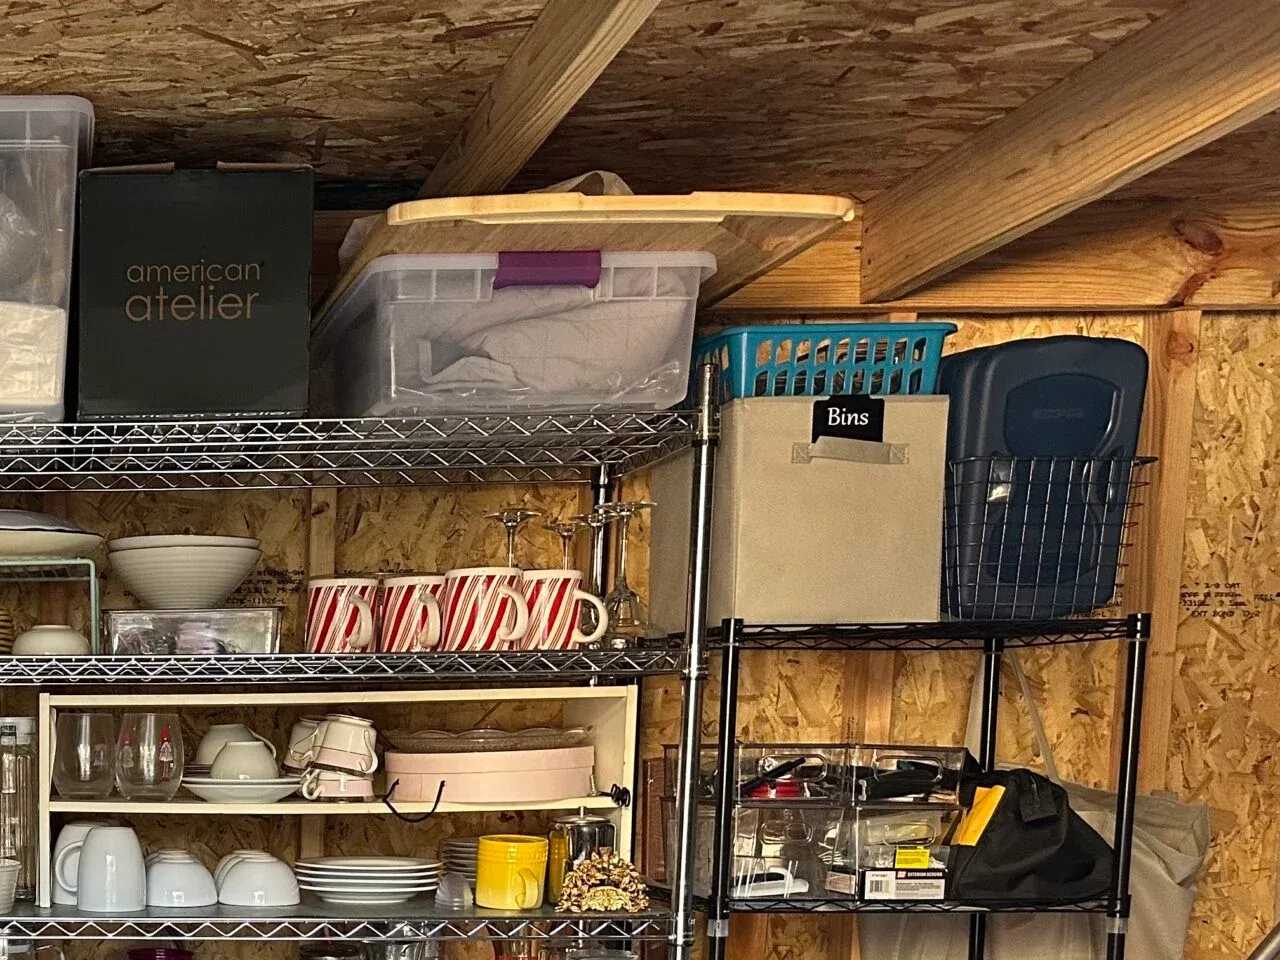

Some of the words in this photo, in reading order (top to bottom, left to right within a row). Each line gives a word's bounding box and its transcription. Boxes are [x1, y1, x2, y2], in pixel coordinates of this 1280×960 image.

[127, 259, 261, 282] american
[125, 285, 260, 321] atelier
[828, 407, 869, 426] Bins
